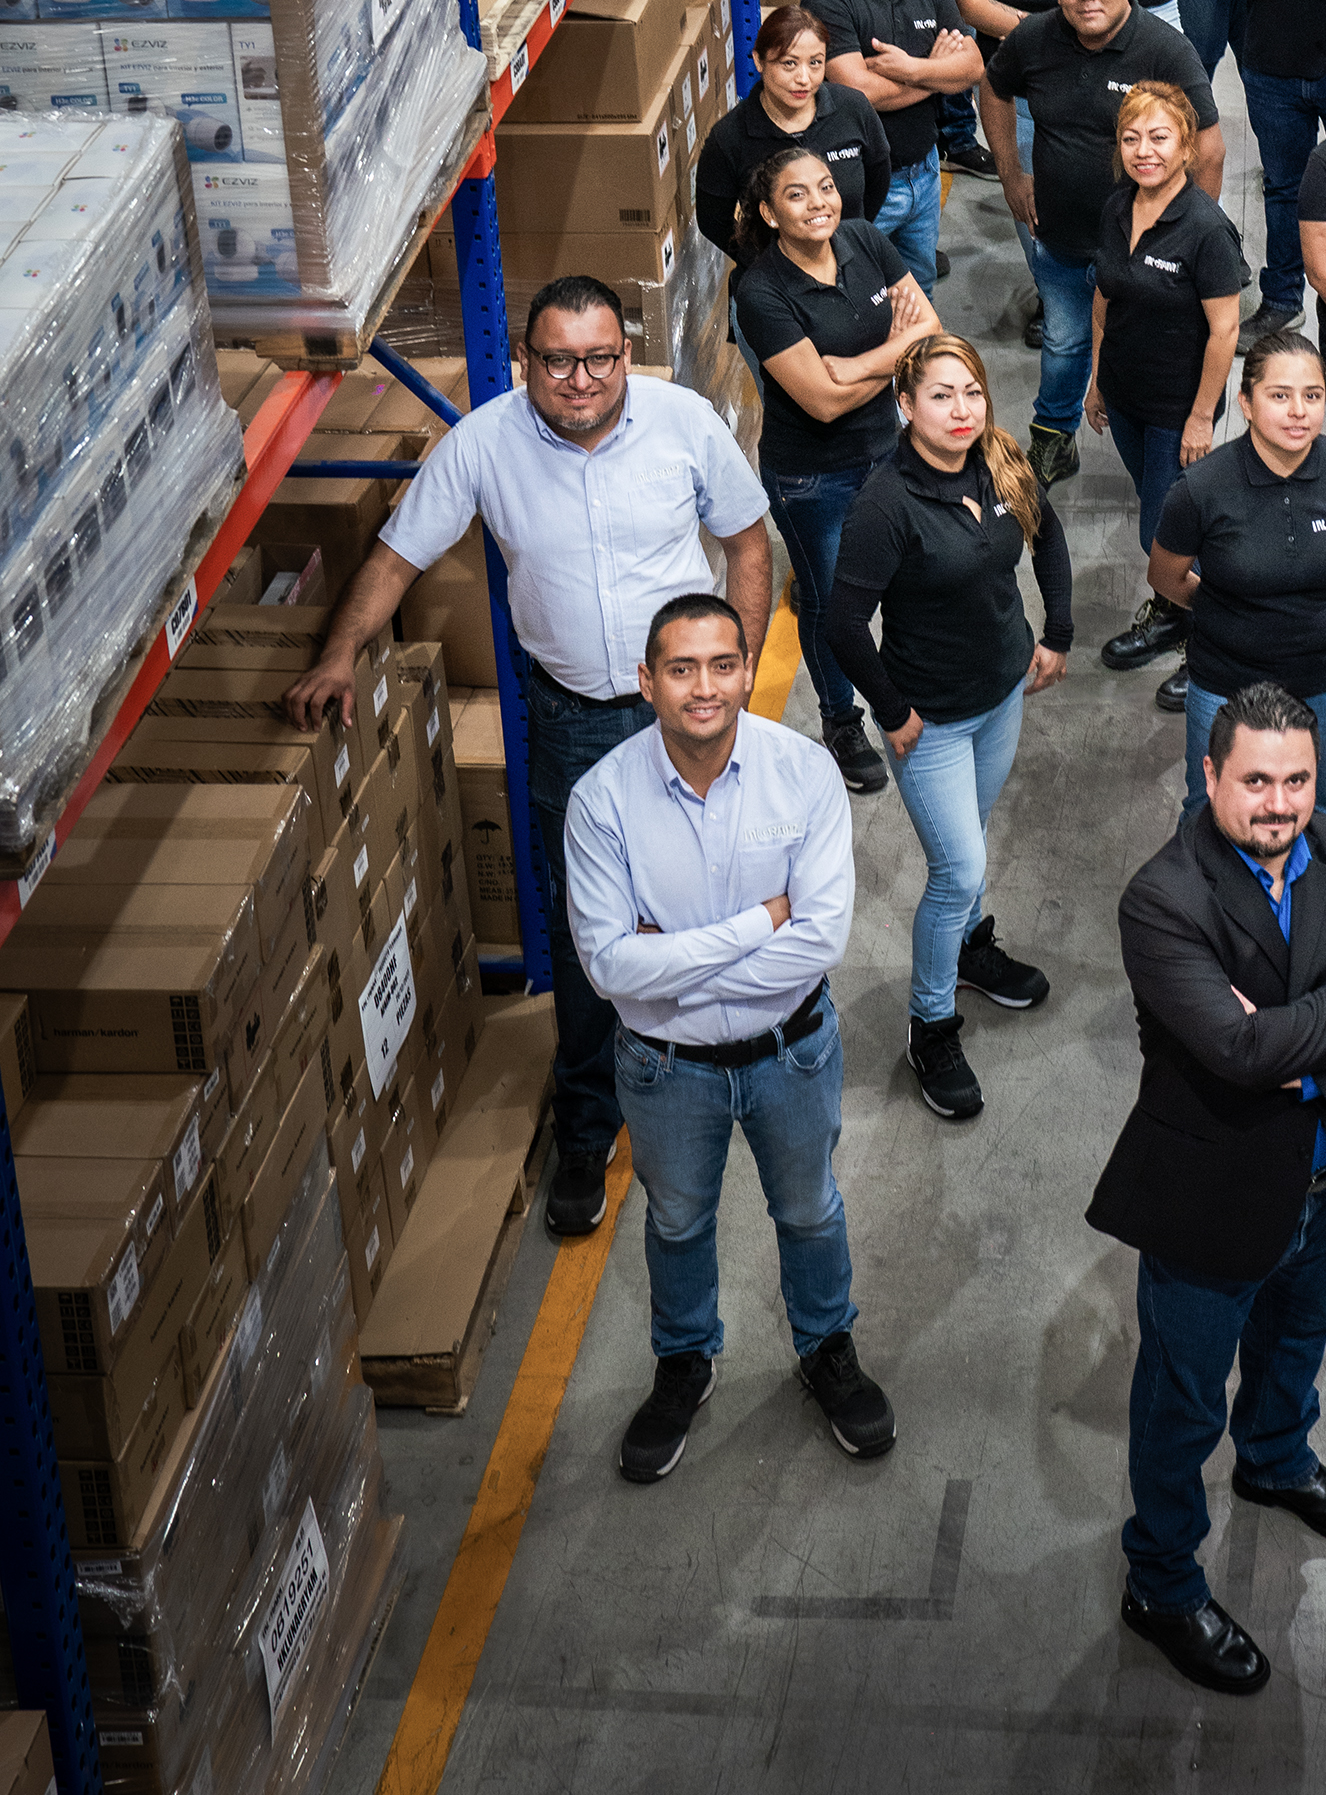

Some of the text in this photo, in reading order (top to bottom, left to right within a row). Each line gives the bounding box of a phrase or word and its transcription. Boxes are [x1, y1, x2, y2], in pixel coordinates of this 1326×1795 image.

[131, 39, 168, 49] EZVIZ
[239, 41, 256, 50] TY1
[199, 94, 224, 103] COLOR
[222, 177, 259, 187] EZVIZ
[1145, 254, 1180, 274] INGRAM
[54, 1027, 139, 1039] harman/kardon
[381, 1036, 390, 1060] 12
